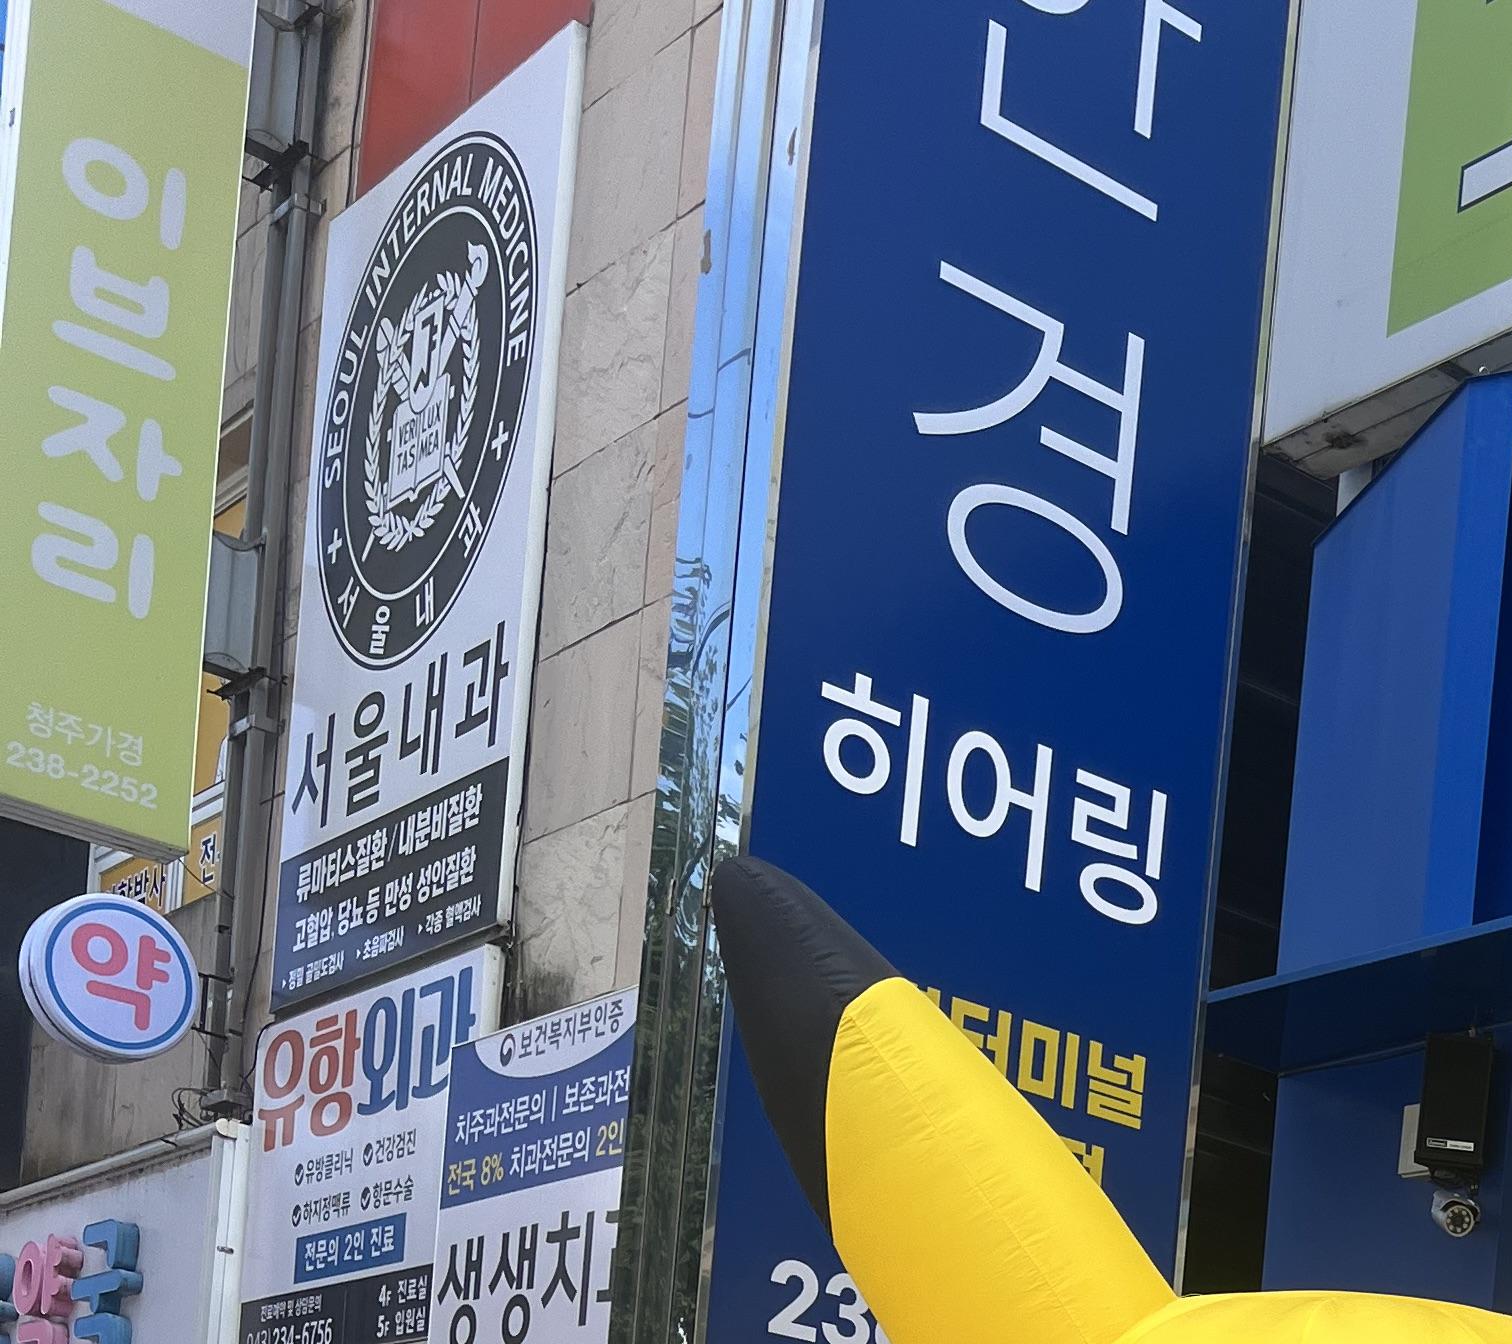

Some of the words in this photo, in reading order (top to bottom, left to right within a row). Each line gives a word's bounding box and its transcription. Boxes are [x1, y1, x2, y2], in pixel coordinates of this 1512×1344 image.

[325, 325, 367, 489] SEOUL
[366, 153, 473, 309] INTERNAL
[478, 156, 529, 367] MEDICINE
[30, 137, 187, 620] 이브자리
[421, 400, 442, 432] LUX
[397, 451, 415, 476] TAS
[420, 434, 439, 460] MEA
[25, 700, 144, 767] 청주가경
[293, 621, 509, 828] 서울내과
[5, 741, 158, 811] 238-2252
[820, 672, 1168, 924] 히어링
[70, 923, 171, 1030] 약
[257, 966, 476, 1152] 유항외과
[518, 999, 624, 1059] 보건복지부인증
[917, 983, 1146, 1130] 터미널
[455, 1088, 546, 1146] 치주과전문의
[304, 1148, 354, 1184] 유방클리닉
[375, 1129, 417, 1165] 건강검진
[448, 1159, 477, 1196] 전국
[480, 1152, 504, 1186] 8%
[509, 1127, 591, 1179] 치과전문의
[595, 1118, 625, 1156] 2인
[303, 1192, 351, 1226] 하지정맥류
[372, 1174, 415, 1204] 항문수술
[304, 1236, 339, 1272] 전문의
[343, 1230, 365, 1262] 2인
[370, 1225, 395, 1258] 진료
[376, 1315, 390, 1338] 5F
[395, 1306, 426, 1336] 입원실
[378, 1284, 393, 1307] 4F
[397, 1275, 428, 1302] 진료실
